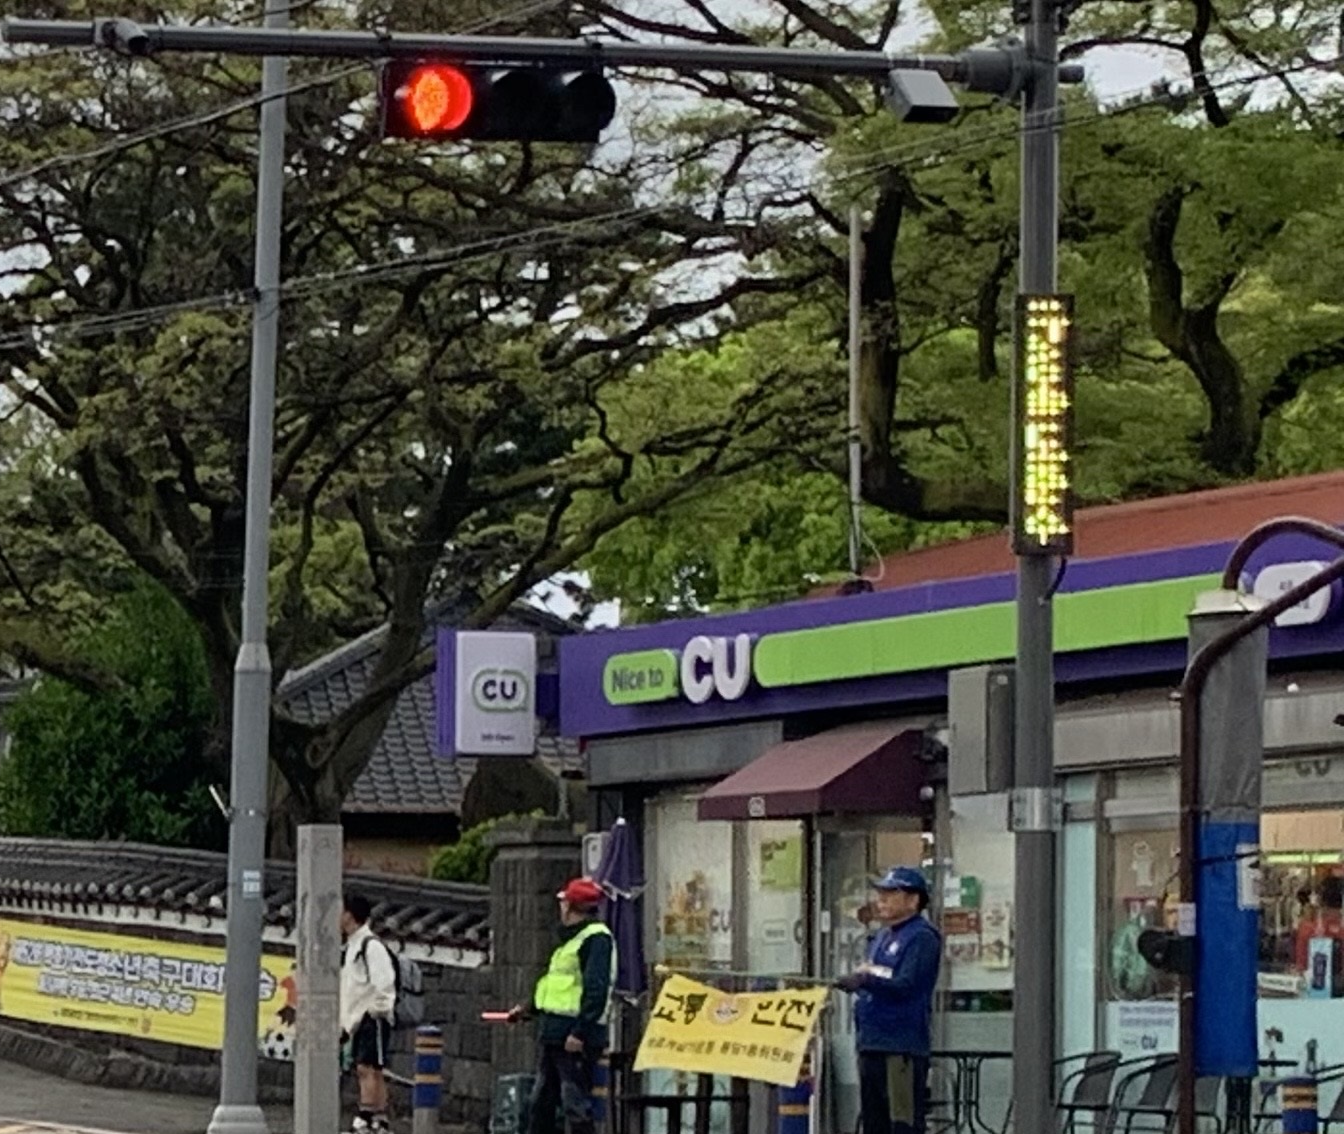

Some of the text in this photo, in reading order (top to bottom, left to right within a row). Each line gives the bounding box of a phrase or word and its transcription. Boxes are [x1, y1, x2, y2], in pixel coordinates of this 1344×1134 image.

[612, 632, 751, 704] Nice to CU
[482, 679, 517, 701] CU
[750, 999, 816, 1033] 안전
